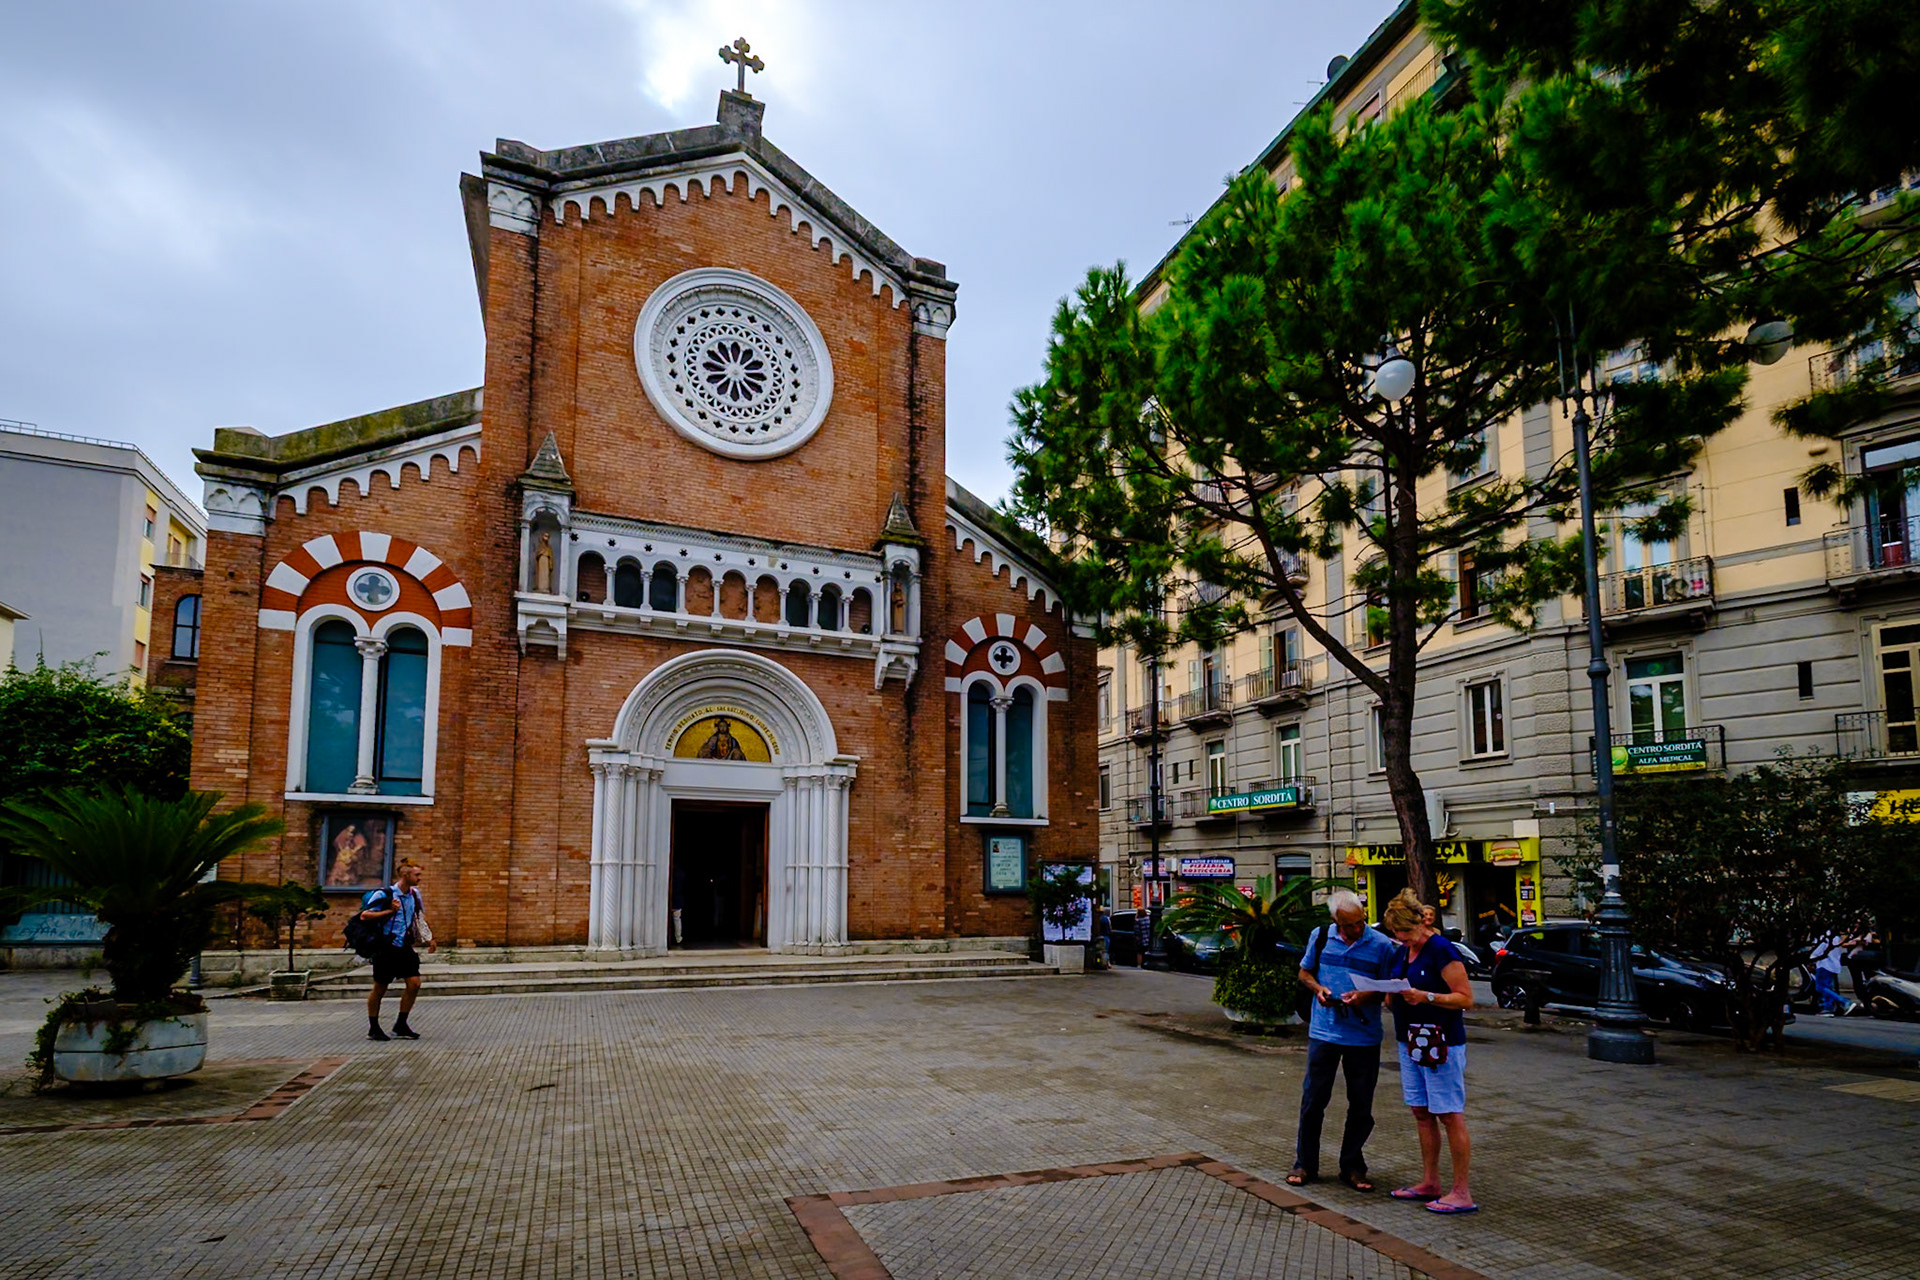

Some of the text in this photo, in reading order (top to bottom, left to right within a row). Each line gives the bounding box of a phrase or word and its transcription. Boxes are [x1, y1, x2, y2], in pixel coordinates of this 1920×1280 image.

[1628, 745, 1662, 755] CENTRO
[1658, 754, 1694, 763] MEDICAL
[1217, 797, 1249, 809] CENTRO
